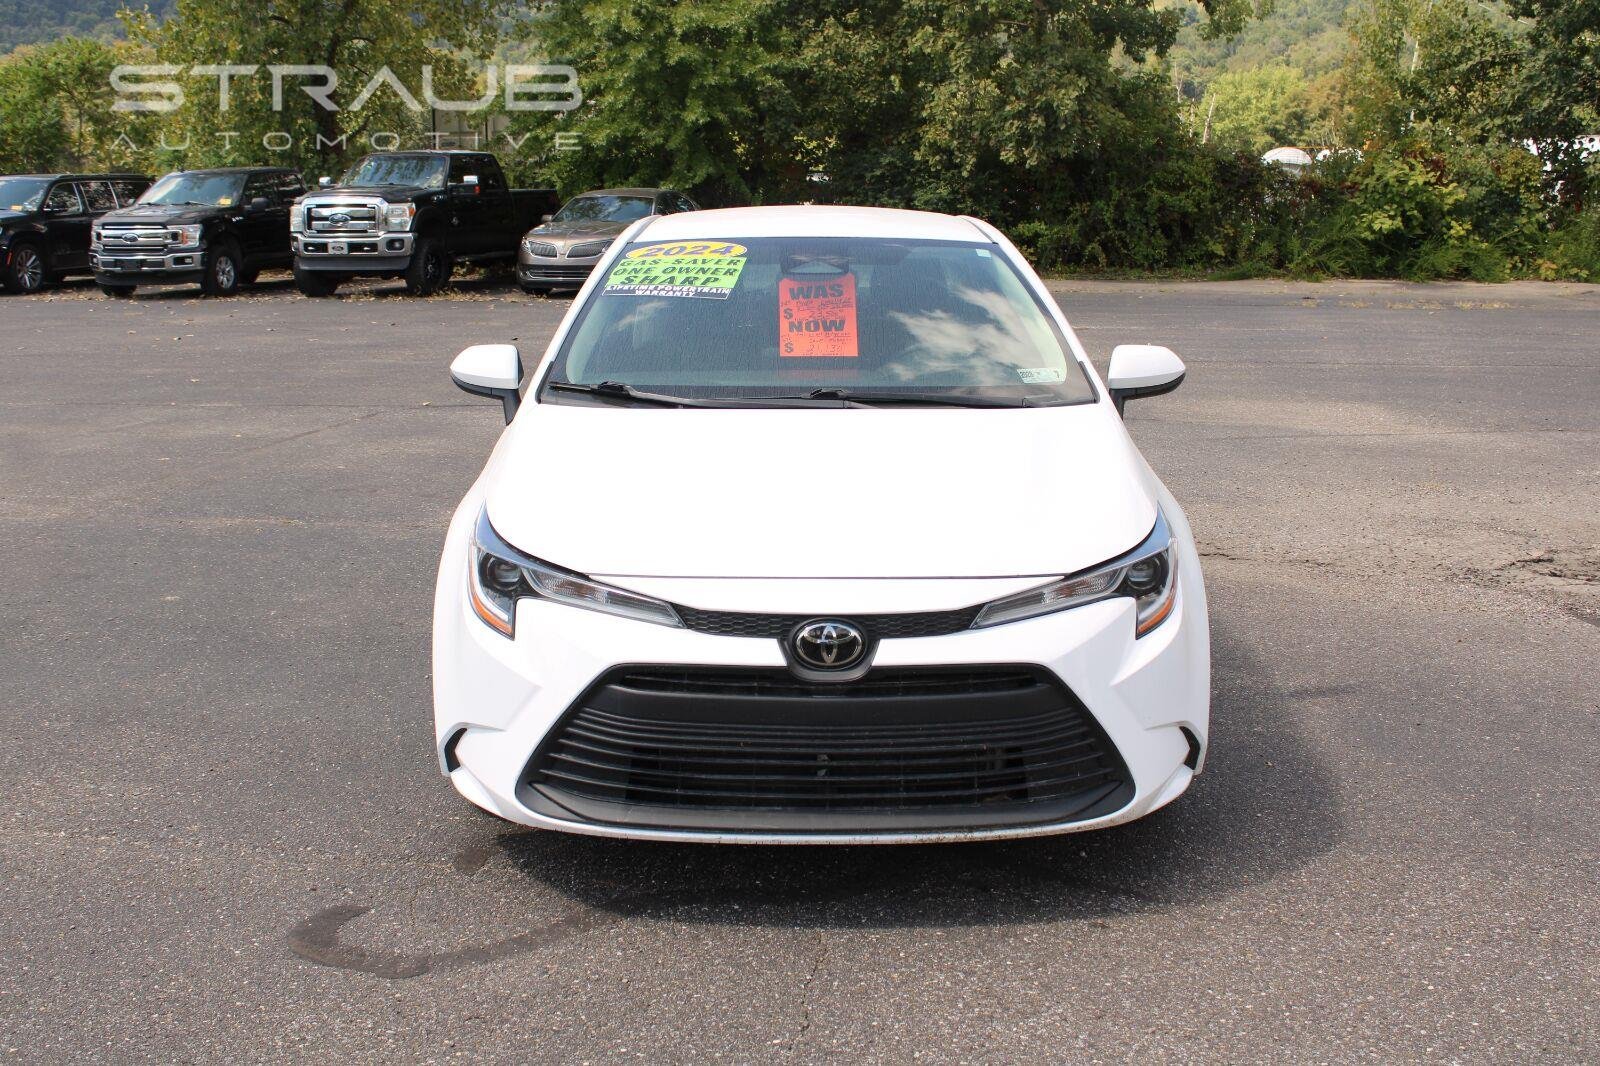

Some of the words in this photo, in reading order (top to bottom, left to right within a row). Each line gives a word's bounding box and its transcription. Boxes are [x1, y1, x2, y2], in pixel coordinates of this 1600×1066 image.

[641, 245, 734, 257] 2024
[619, 258, 743, 267] GAS-SAVER
[612, 266, 657, 276] ONE
[662, 266, 738, 276] OWNER
[619, 275, 720, 286] SHARP
[634, 289, 697, 297] WARRANTY
[656, 285, 732, 294] POWERTRAIN
[789, 284, 844, 300] WAS
[783, 307, 794, 320] $
[788, 319, 846, 333] NOW
[784, 342, 794, 353] $
